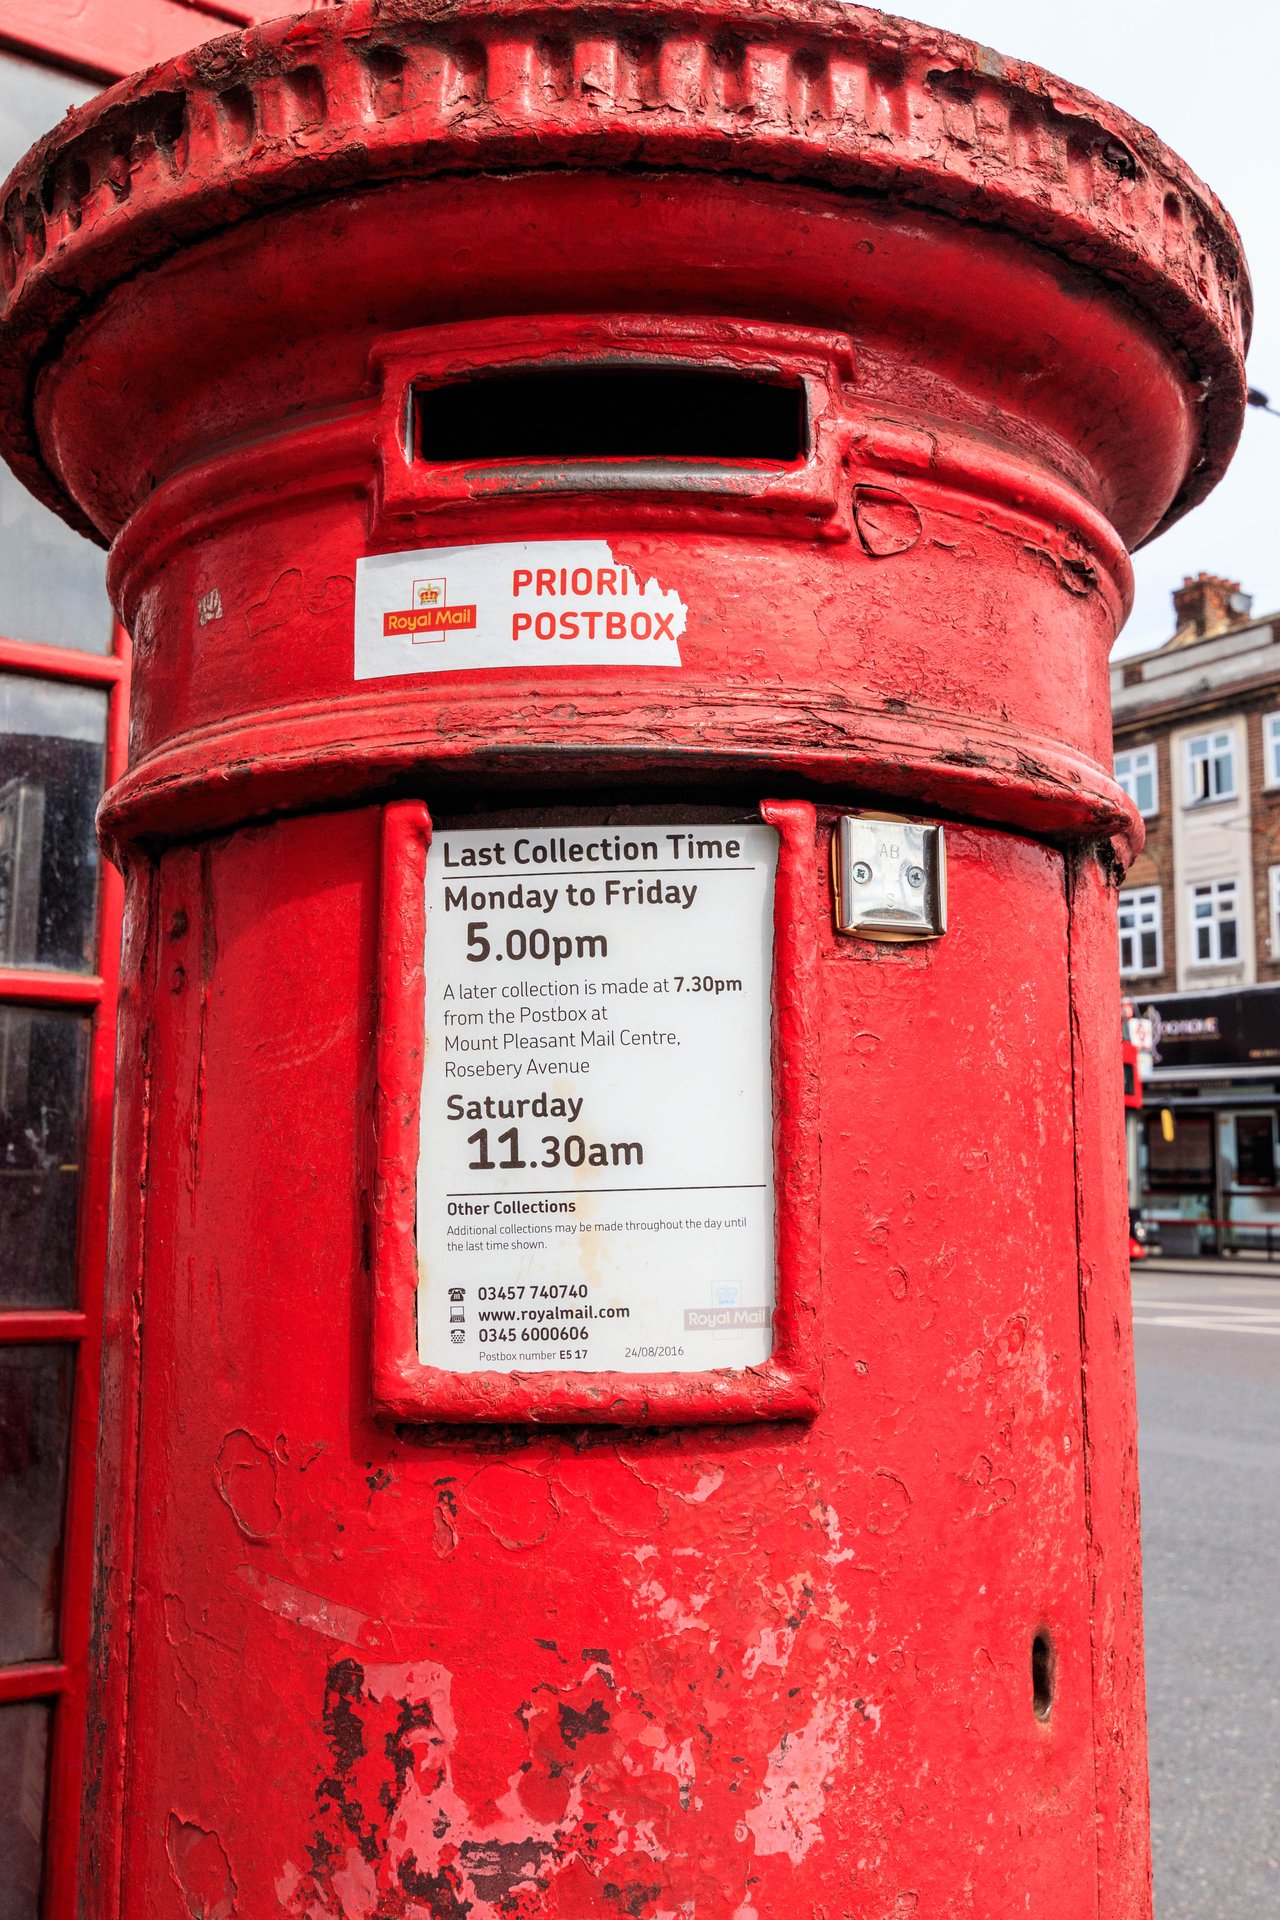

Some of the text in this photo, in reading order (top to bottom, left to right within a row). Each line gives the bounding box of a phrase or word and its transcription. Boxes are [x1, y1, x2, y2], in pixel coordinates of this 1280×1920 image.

[513, 568, 668, 597] PRIORI
[388, 609, 471, 631] Royal Mail
[512, 611, 675, 641] POSTBOX
[444, 834, 740, 867] Last Collection Time
[445, 879, 697, 913] Monday to Friday
[466, 922, 607, 966] 5.00pm
[443, 976, 742, 1000] A later collection is made at 7.30pm
[444, 1006, 608, 1026] from the Postbox at
[445, 1029, 680, 1052] Mount Pleasant Mail Centre,
[446, 1058, 589, 1079] Rosebery Avenue
[447, 1092, 583, 1123] Saturday
[467, 1127, 643, 1170] 11.30am
[447, 1199, 576, 1216] Other Collections
[446, 1216, 746, 1236] Additional collections may be made throughout the day until
[446, 1239, 547, 1251] the last time shown.
[478, 1284, 588, 1301] 03457 740740
[478, 1305, 630, 1323] www.royalmail.com
[688, 1309, 766, 1328] Royal Mail
[479, 1326, 589, 1342] 0345 6000606
[479, 1349, 587, 1361] Postbox number E5 17
[624, 1345, 684, 1357] 24/08/2016
